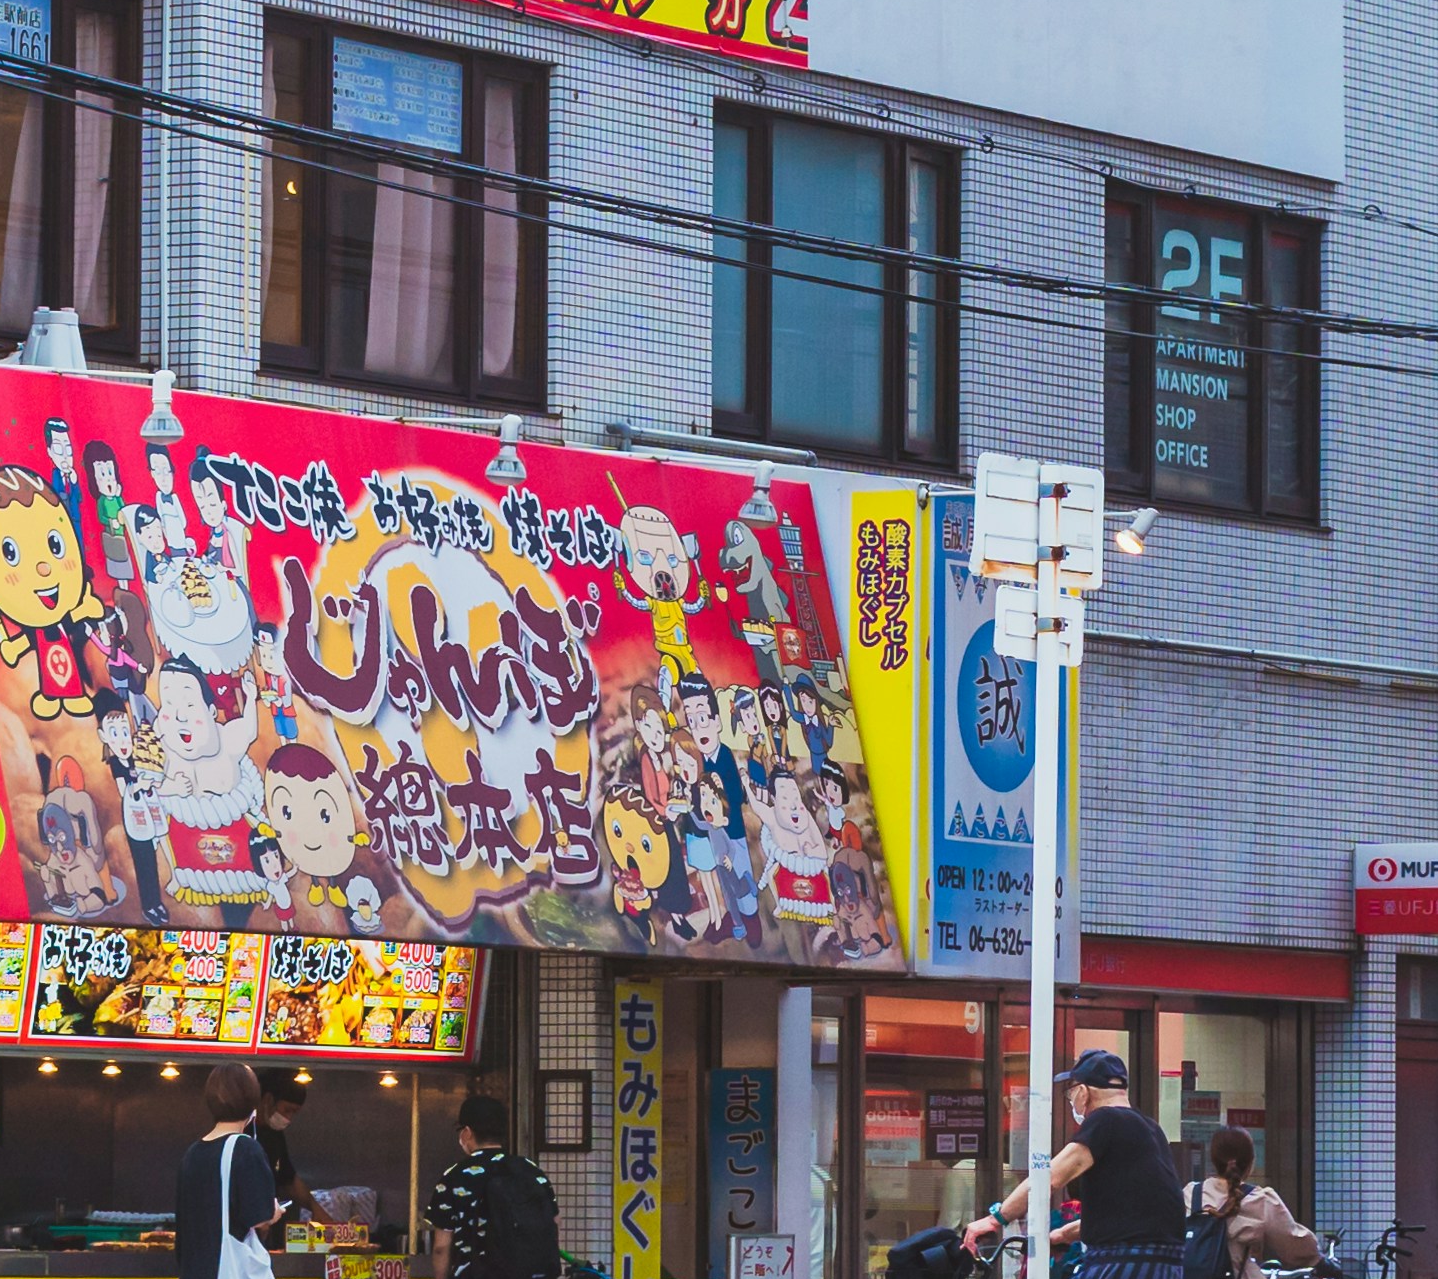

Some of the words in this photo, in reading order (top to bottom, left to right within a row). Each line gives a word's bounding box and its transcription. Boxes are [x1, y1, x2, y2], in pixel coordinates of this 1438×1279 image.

[1160, 229, 1244, 325] 2F
[1156, 333, 1247, 369] APARTMENT
[1156, 369, 1229, 401] MANSION
[1156, 402, 1197, 431] SHOP
[1156, 439, 1209, 469] OFFICE
[205, 453, 357, 546] たこ焼
[366, 470, 495, 555] お好み焼
[500, 485, 621, 570] 焼そば
[856, 521, 882, 648] もみほぐし
[883, 519, 909, 671] 酸素カプセル
[281, 556, 602, 736] じゃんぼ
[975, 655, 1026, 756] 誠
[937, 864, 966, 890] OPEN
[271, 935, 355, 988] 焼そば
[937, 922, 962, 952] TEL
[726, 1075, 765, 1230] まごこ
